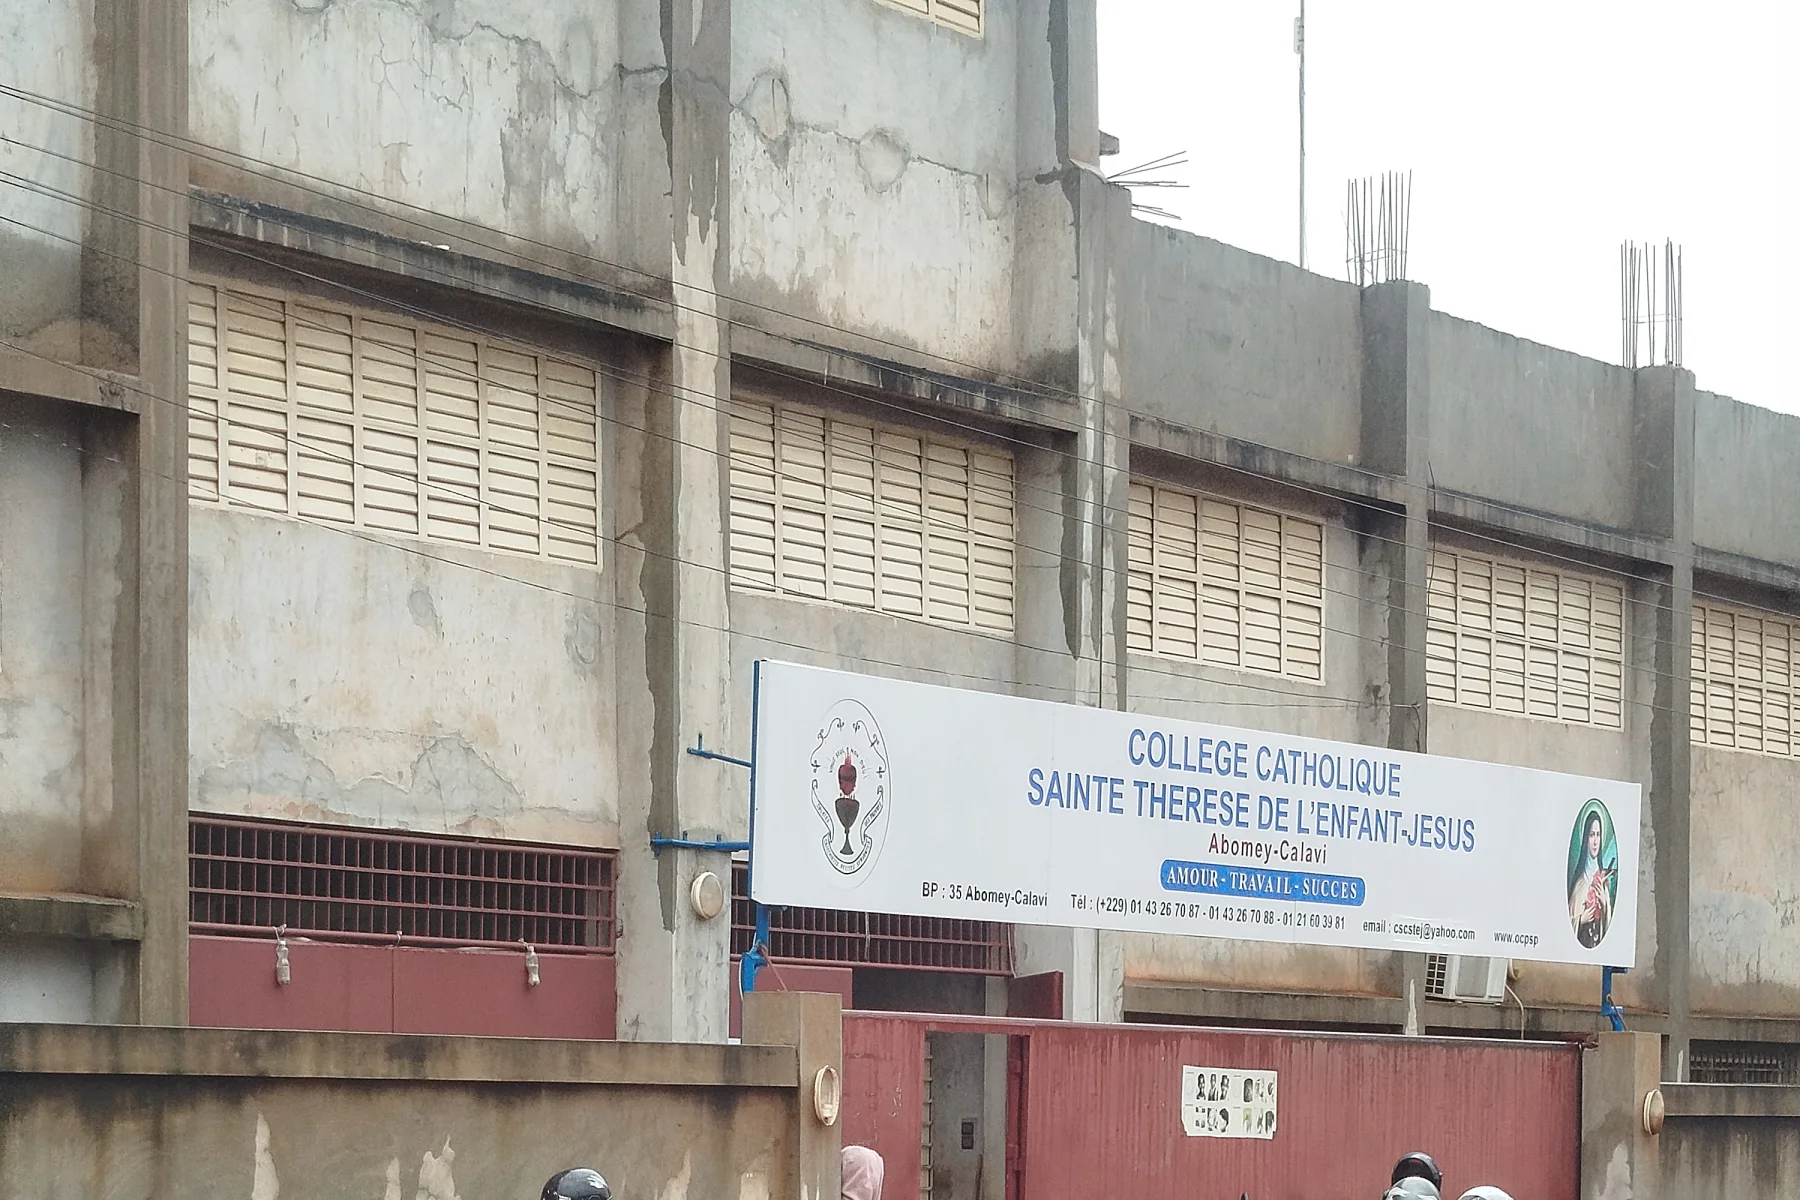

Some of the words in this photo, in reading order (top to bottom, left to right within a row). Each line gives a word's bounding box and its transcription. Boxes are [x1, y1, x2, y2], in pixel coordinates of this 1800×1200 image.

[1128, 728, 1248, 779] COLLEGE
[1256, 745, 1401, 798] CATHOLIQUE
[1027, 767, 1125, 815] SAINTE
[1133, 780, 1250, 829] THERESE
[1257, 795, 1289, 833] DE
[1297, 799, 1475, 853] L'ENFANT-JESUS
[1209, 832, 1327, 865] Abomey-Calavi
[922, 881, 939, 898] BP
[949, 883, 962, 900] 35
[965, 885, 1048, 908] Abomey-Calavi
[1166, 866, 1218, 888] AMOUR
[1230, 871, 1292, 895] TRAVAIL
[1302, 877, 1357, 900] SUCCES
[1096, 896, 1128, 917] (+229)
[1130, 899, 1142, 914] 01
[1145, 900, 1157, 915] 43
[1160, 901, 1172, 916] 26
[1174, 902, 1186, 918] 70
[1188, 903, 1200, 919] 87
[1208, 905, 1219, 921] 01
[1222, 907, 1234, 922] 43
[1236, 908, 1248, 923] 26
[1250, 909, 1261, 924] 70
[1263, 910, 1275, 925] 88
[1282, 912, 1293, 926] 01
[1296, 913, 1307, 927] 21
[1309, 914, 1320, 928] 60
[1322, 915, 1333, 929] 39
[1335, 916, 1345, 930] 81
[1362, 919, 1386, 933] email
[1393, 922, 1476, 940] cscstej@yahoo.com
